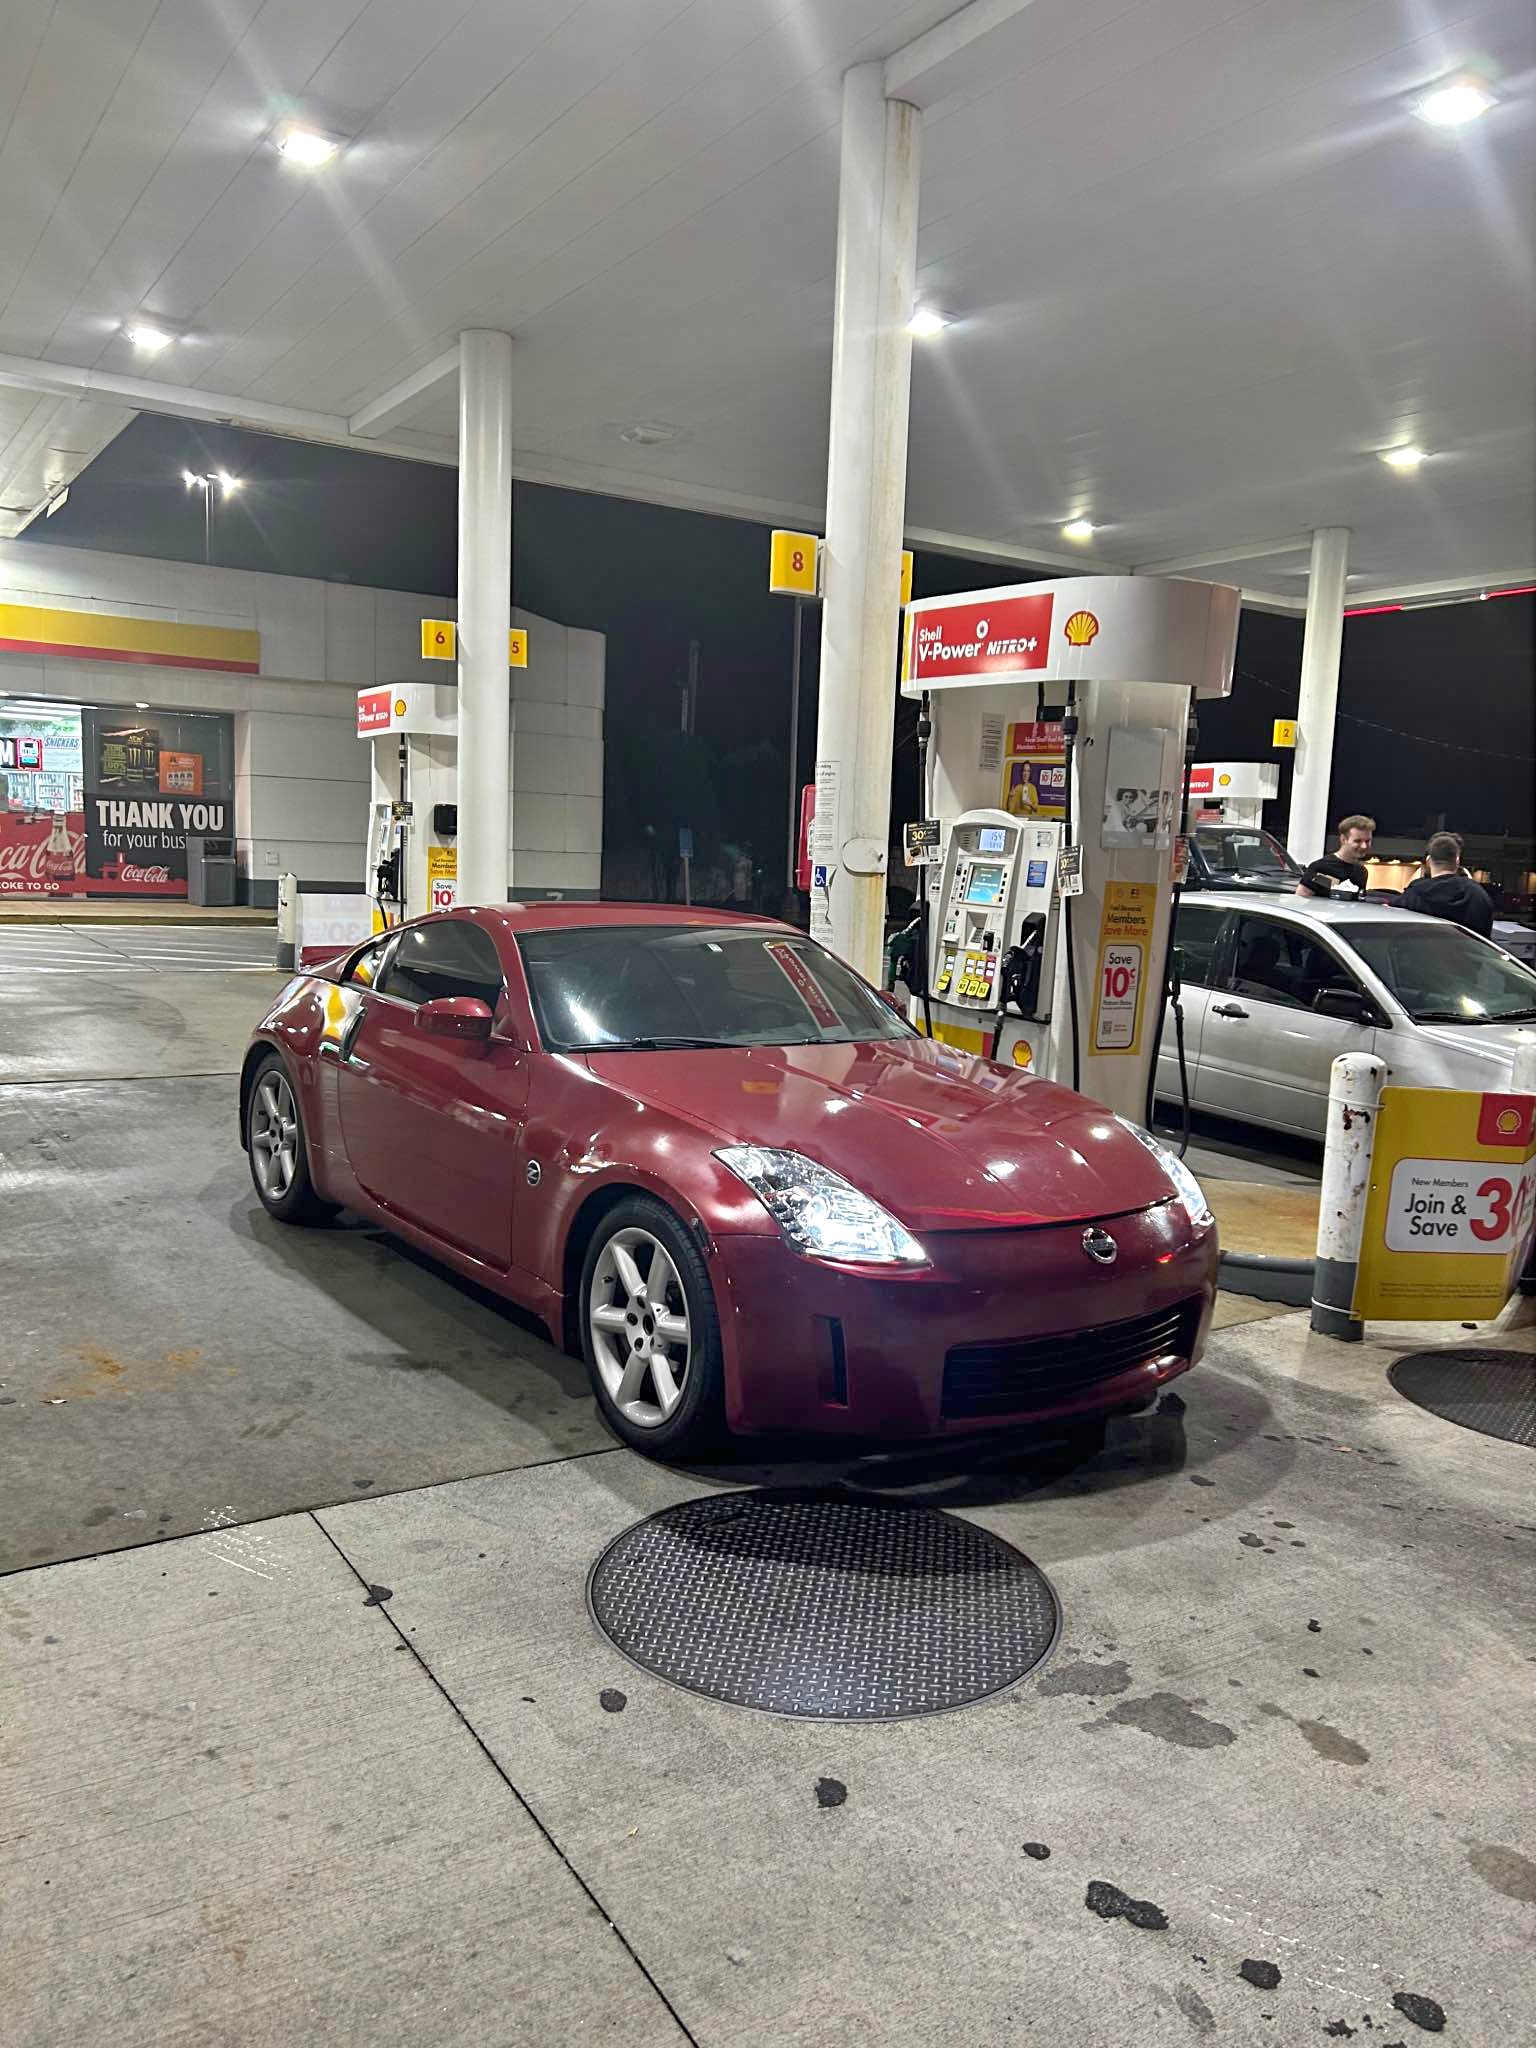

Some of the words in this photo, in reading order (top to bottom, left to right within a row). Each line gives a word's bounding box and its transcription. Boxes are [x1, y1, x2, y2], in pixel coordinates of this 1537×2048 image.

[792, 551, 804, 572] 8
[435, 631, 445, 644] 6
[919, 626, 942, 642] Shell
[511, 641, 520, 654] 5
[919, 642, 981, 662] V-Power
[986, 636, 1038, 656] NITRO+
[1283, 728, 1290, 738] 2
[44, 737, 80, 748] SNICKERS
[96, 800, 174, 829] THANK
[179, 803, 224, 831] YOU
[103, 830, 122, 848] for
[127, 833, 158, 849] your
[161, 832, 188, 849] bus
[1107, 913, 1146, 924] Members
[1125, 925, 1149, 936] More
[1109, 952, 1133, 964] Save
[1412, 1177, 1430, 1186] New
[1432, 1178, 1469, 1188] Members
[1404, 1193, 1445, 1214] Join
[1451, 1194, 1467, 1215] &
[1409, 1216, 1458, 1237] Save
